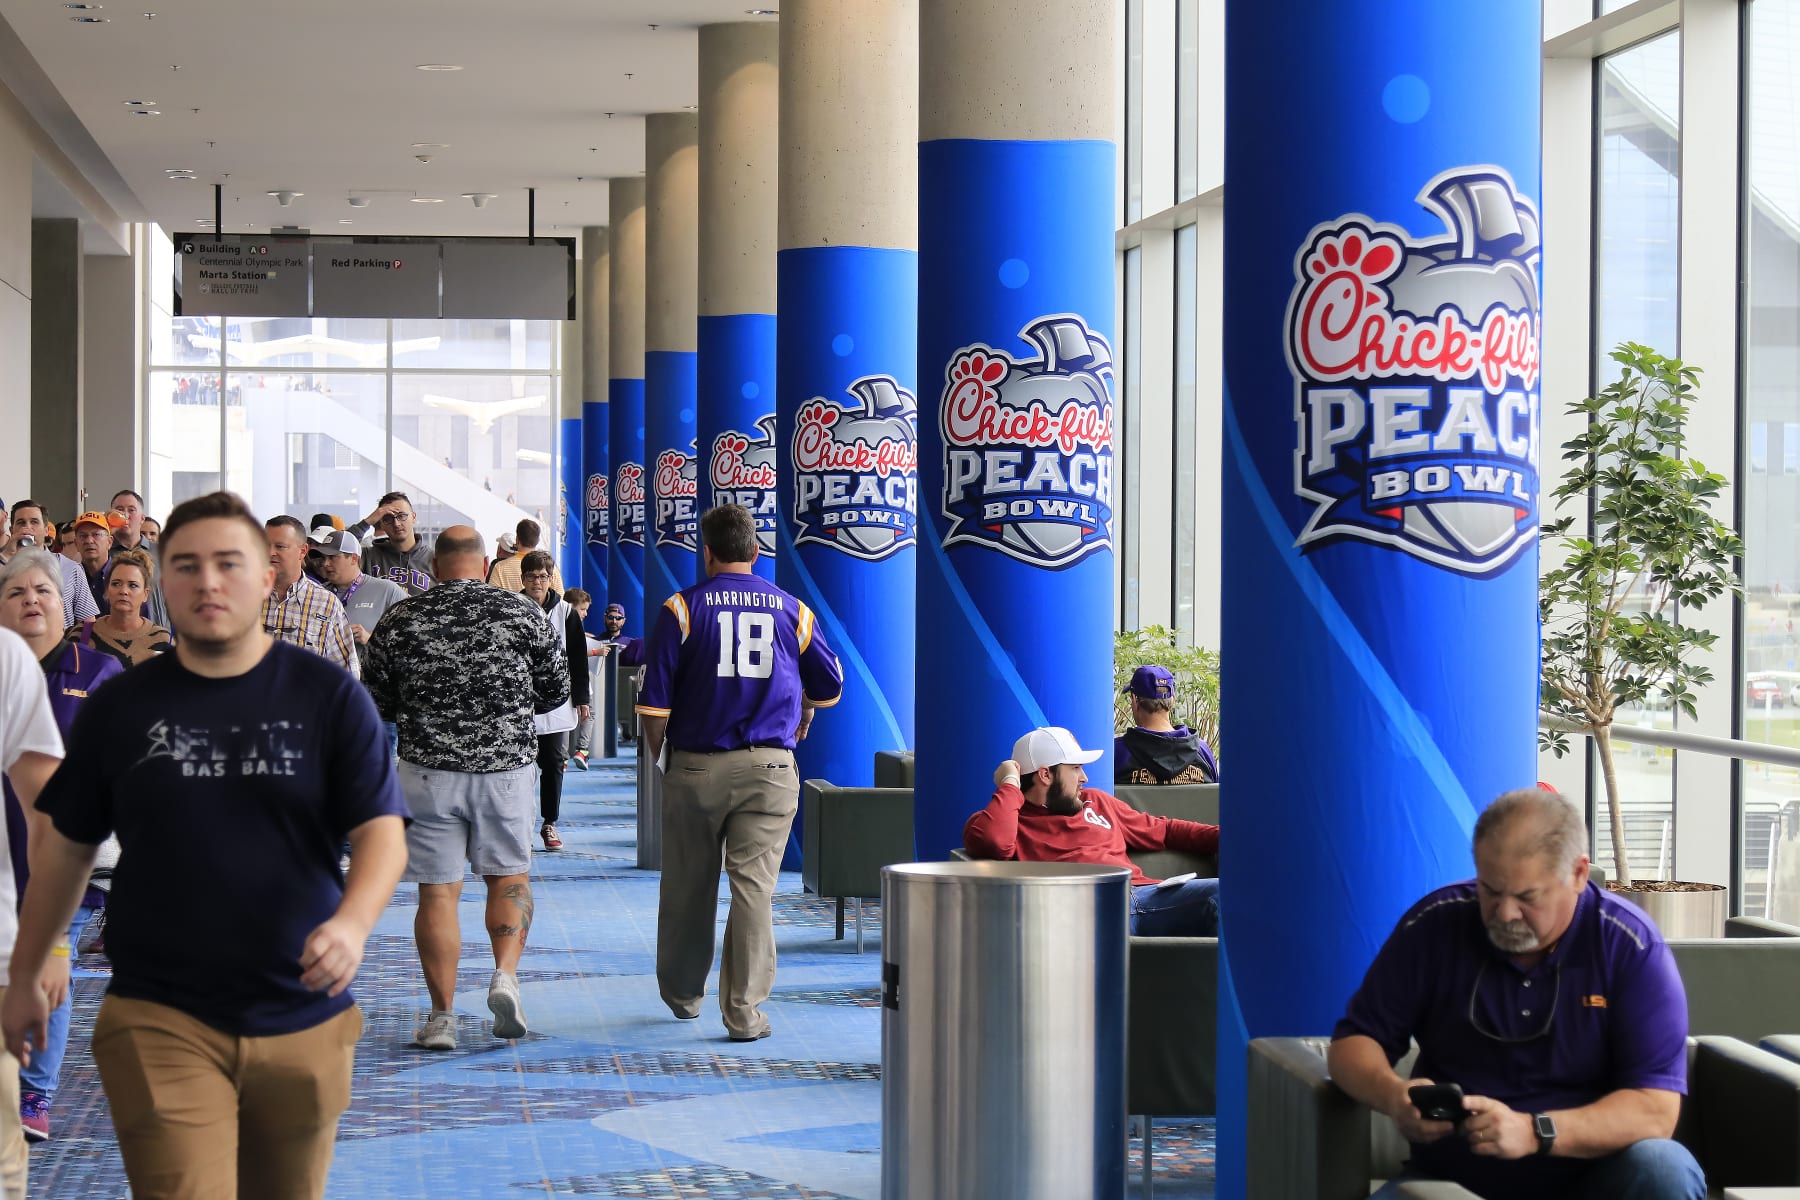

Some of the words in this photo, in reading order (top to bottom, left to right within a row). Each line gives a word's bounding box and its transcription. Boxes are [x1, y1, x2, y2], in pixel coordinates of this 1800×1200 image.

[200, 244, 240, 254] Building
[200, 257, 242, 267] Centennial
[245, 258, 281, 268] Olympic
[285, 258, 303, 267] Park
[331, 259, 350, 267] Red
[353, 259, 390, 269] Parking
[200, 270, 229, 279] Marta
[232, 270, 267, 280] Station
[948, 450, 1113, 507] PEACH
[1371, 463, 1530, 500] BOWL
[822, 509, 906, 528] BOWL
[983, 499, 1097, 524] BOWL
[705, 591, 783, 611] HARRINGTON
[717, 611, 775, 679] 18
